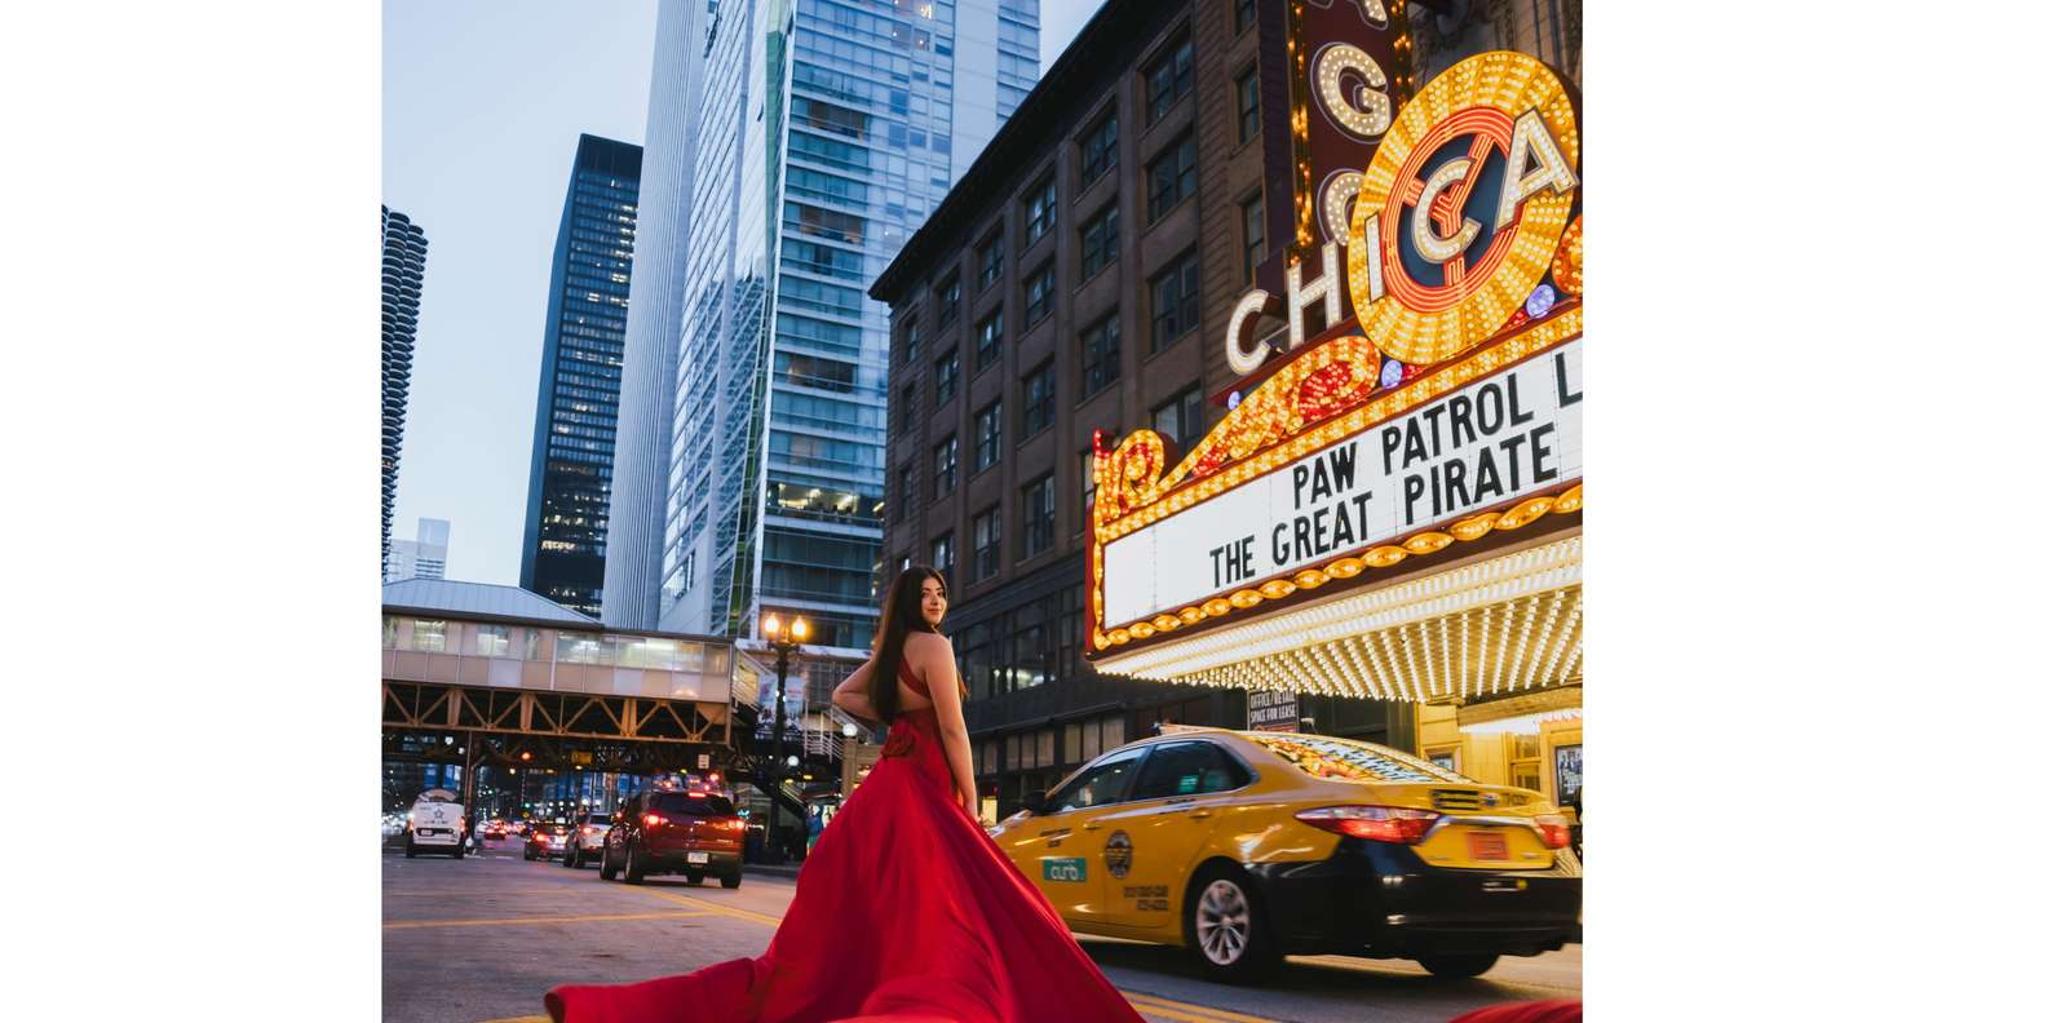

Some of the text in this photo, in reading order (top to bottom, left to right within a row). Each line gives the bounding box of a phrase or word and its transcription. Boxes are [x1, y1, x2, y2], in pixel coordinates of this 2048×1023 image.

[1226, 106, 1580, 376] CHICA
[1210, 422, 1558, 588] THE GREAT PIRATE
[1293, 441, 1358, 510] PAW
[1382, 373, 1534, 476] PATROL
[1250, 704, 1296, 723] SPACE FOR LEASE
